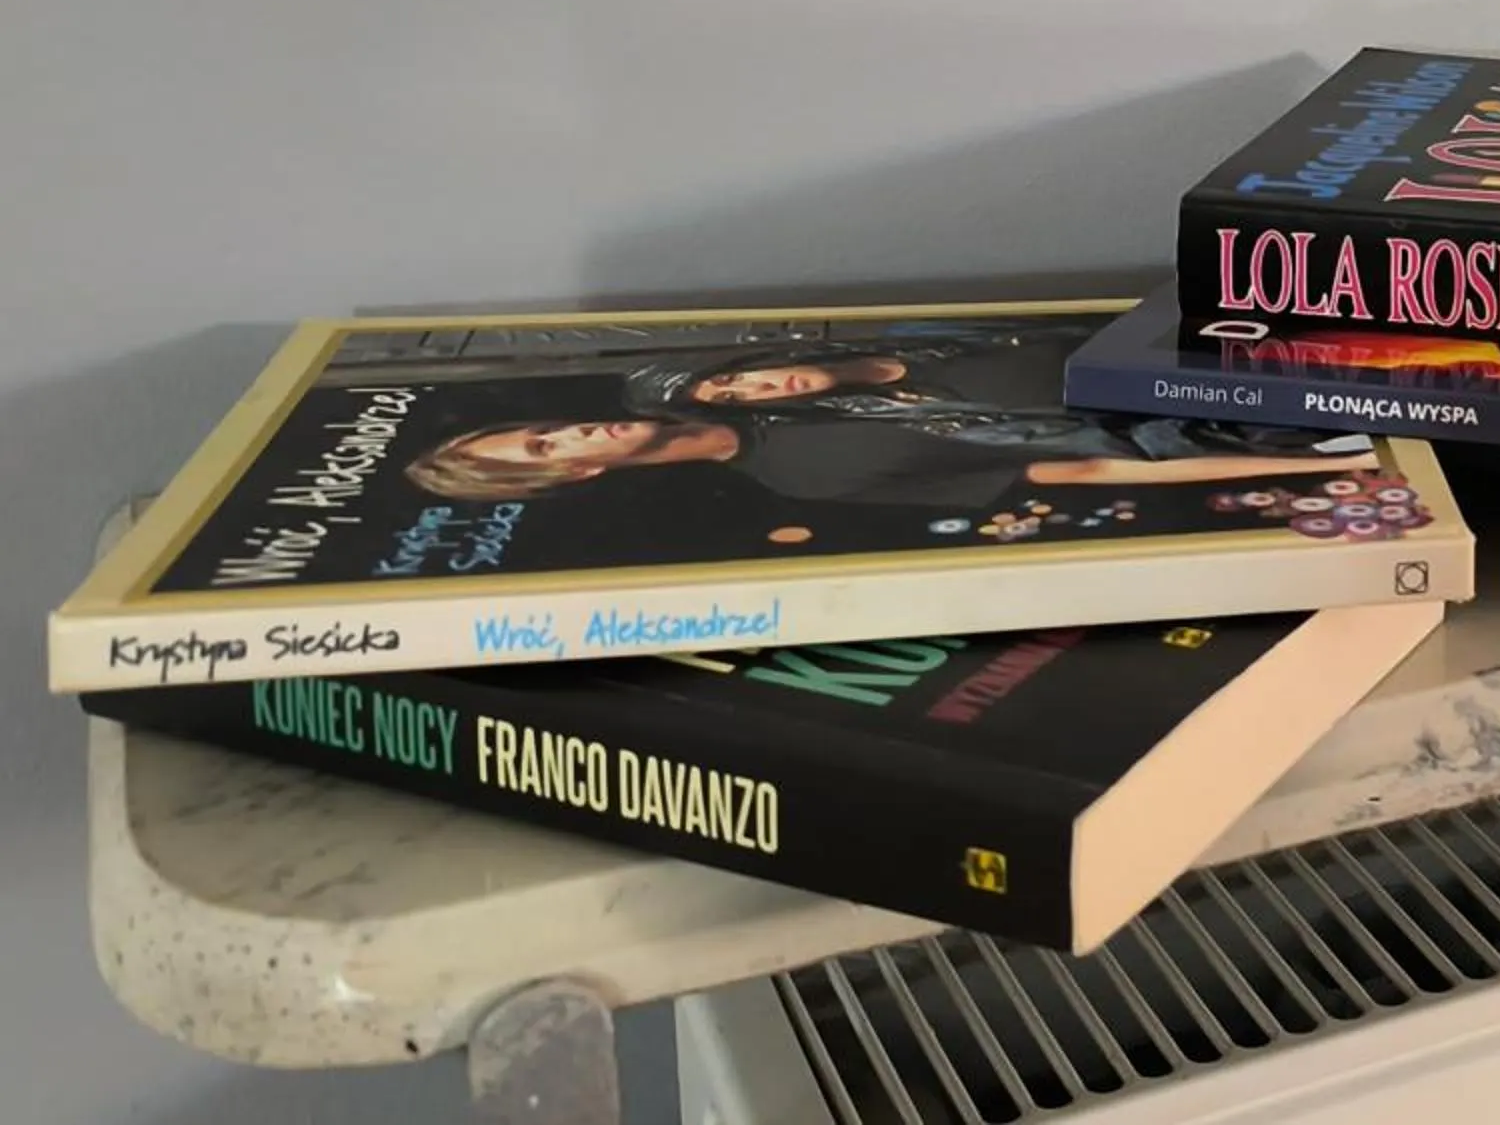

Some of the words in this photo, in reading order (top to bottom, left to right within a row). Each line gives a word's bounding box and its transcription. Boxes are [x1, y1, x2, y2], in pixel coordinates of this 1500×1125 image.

[1217, 228, 1374, 320] LOLA
[1153, 380, 1227, 404] Damian
[1233, 386, 1263, 407] Cal
[1304, 392, 1403, 421] PŁONĄCA
[1406, 402, 1479, 426] WYSPA
[266, 386, 435, 508] Aleksandrze!
[109, 629, 248, 684] Krystyna
[264, 621, 400, 660] Siesicka
[474, 610, 567, 660] Wróć,
[583, 596, 780, 647] Aleksandrze!
[252, 676, 366, 754] KONIEC
[372, 690, 459, 776] NOCY
[477, 714, 609, 812] FRANCO
[618, 748, 779, 855] DAVANZO
